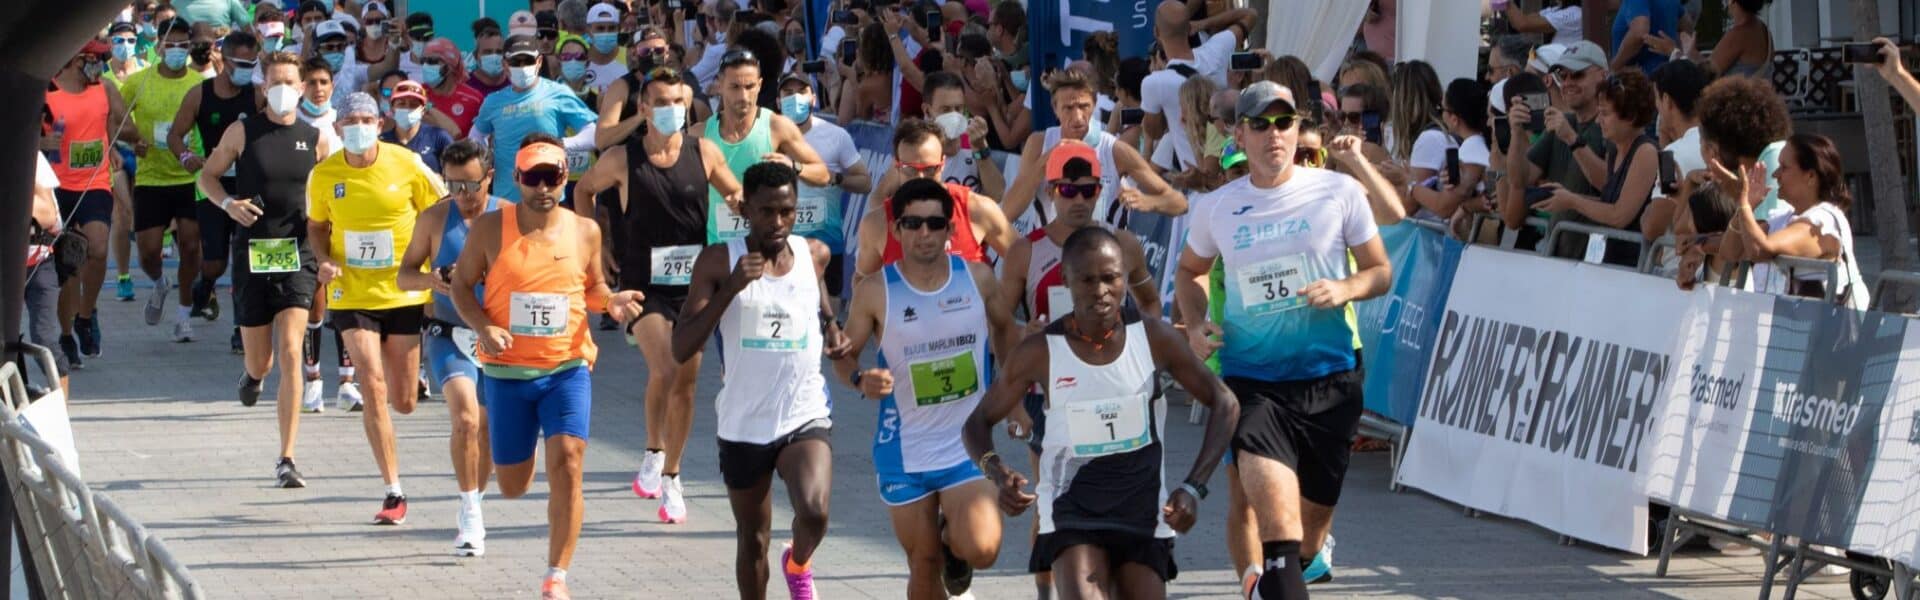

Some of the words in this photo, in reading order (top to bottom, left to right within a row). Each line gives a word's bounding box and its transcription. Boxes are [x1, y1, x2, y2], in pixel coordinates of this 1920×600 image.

[1256, 219, 1311, 237] IBIZA
[359, 246, 377, 260] 77
[664, 260, 692, 276] 295
[1262, 280, 1289, 300] 36
[530, 310, 551, 327] 15
[771, 320, 781, 339] 2
[941, 376, 953, 392] 3
[1782, 383, 1864, 436] Trasmed
[1105, 422, 1116, 441] 1
